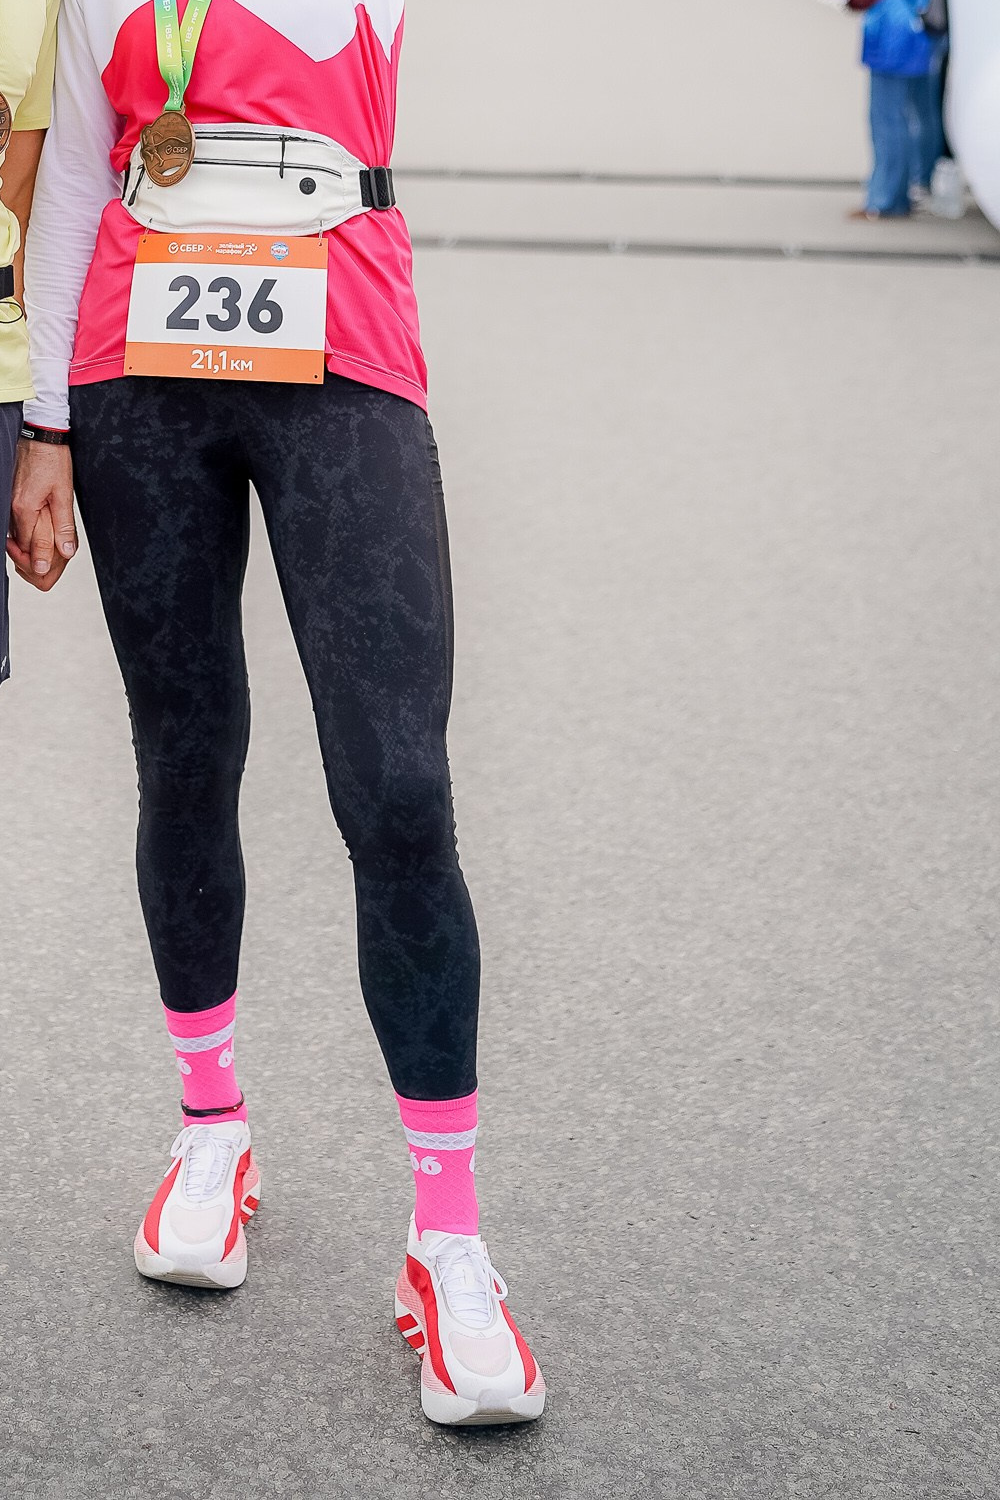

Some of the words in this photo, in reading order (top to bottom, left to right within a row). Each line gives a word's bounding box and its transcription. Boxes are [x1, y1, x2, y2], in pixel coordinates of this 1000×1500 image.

[164, 23, 172, 40] 185
[185, 26, 194, 43] 185
[180, 243, 204, 253] СБЕР
[166, 275, 283, 334] 236
[191, 349, 227, 373] 21,1
